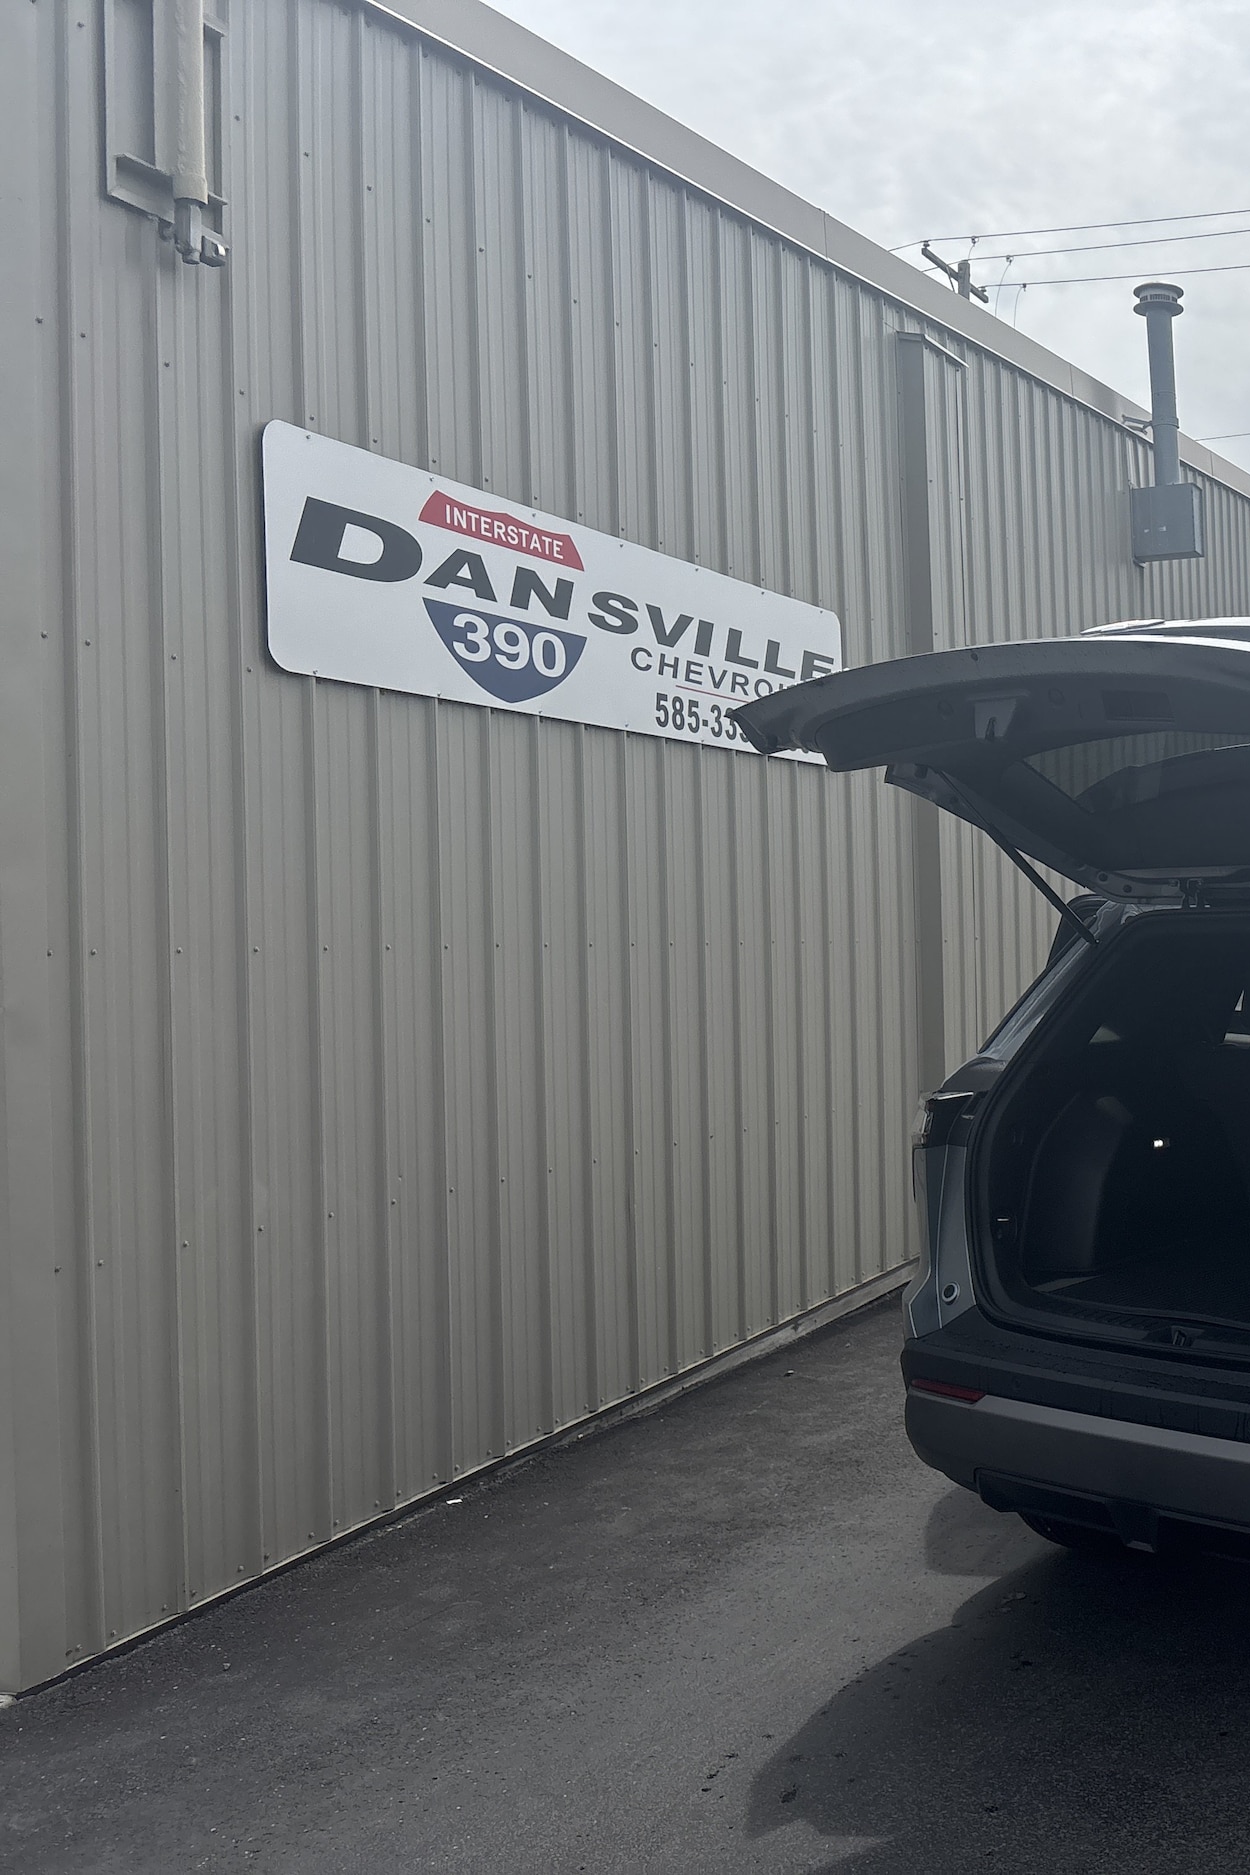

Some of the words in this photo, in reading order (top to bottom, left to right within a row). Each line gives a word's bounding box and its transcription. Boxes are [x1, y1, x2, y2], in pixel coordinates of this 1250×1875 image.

[445, 504, 564, 560] INTERSTATE
[289, 496, 834, 680] DANSVILLE
[452, 612, 567, 678] 390
[630, 647, 795, 698] CHEVRO
[655, 692, 749, 743] 585-33
